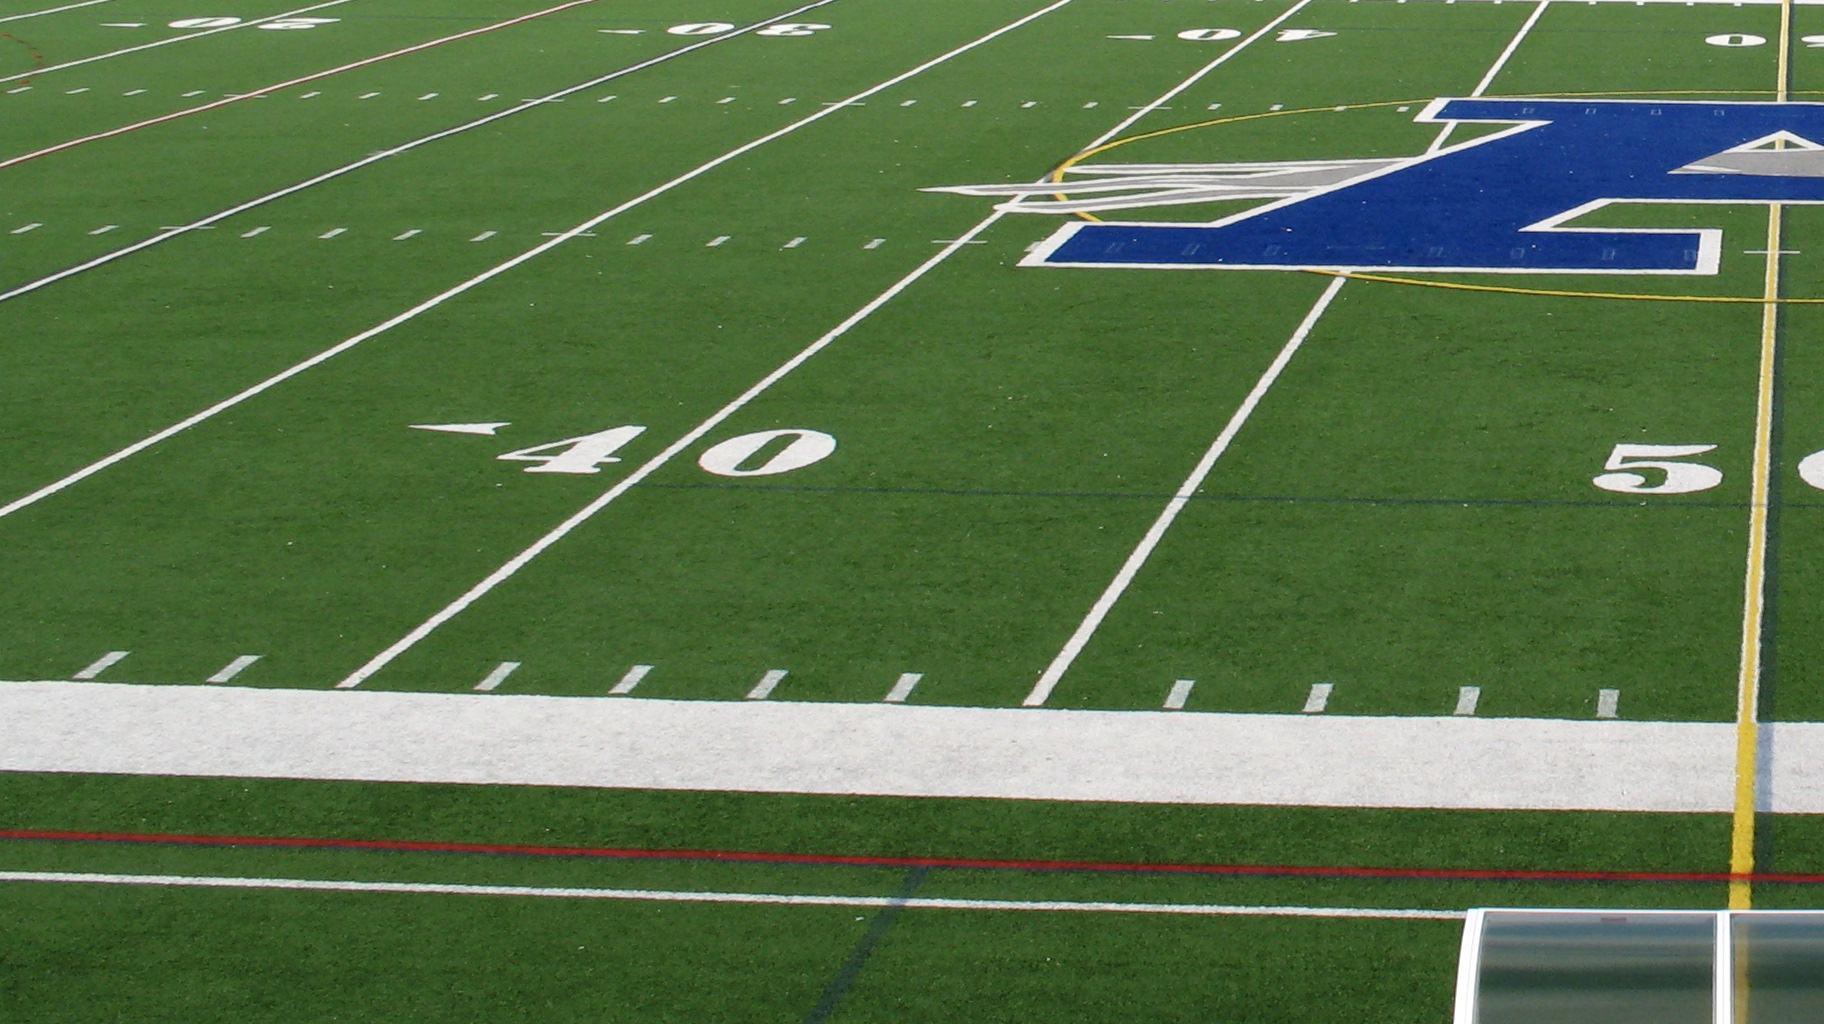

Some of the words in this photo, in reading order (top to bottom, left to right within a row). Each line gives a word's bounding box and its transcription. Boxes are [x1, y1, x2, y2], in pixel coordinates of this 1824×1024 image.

[668, 22, 832, 36] 30
[1178, 28, 1338, 42] 40
[497, 425, 837, 477] 40
